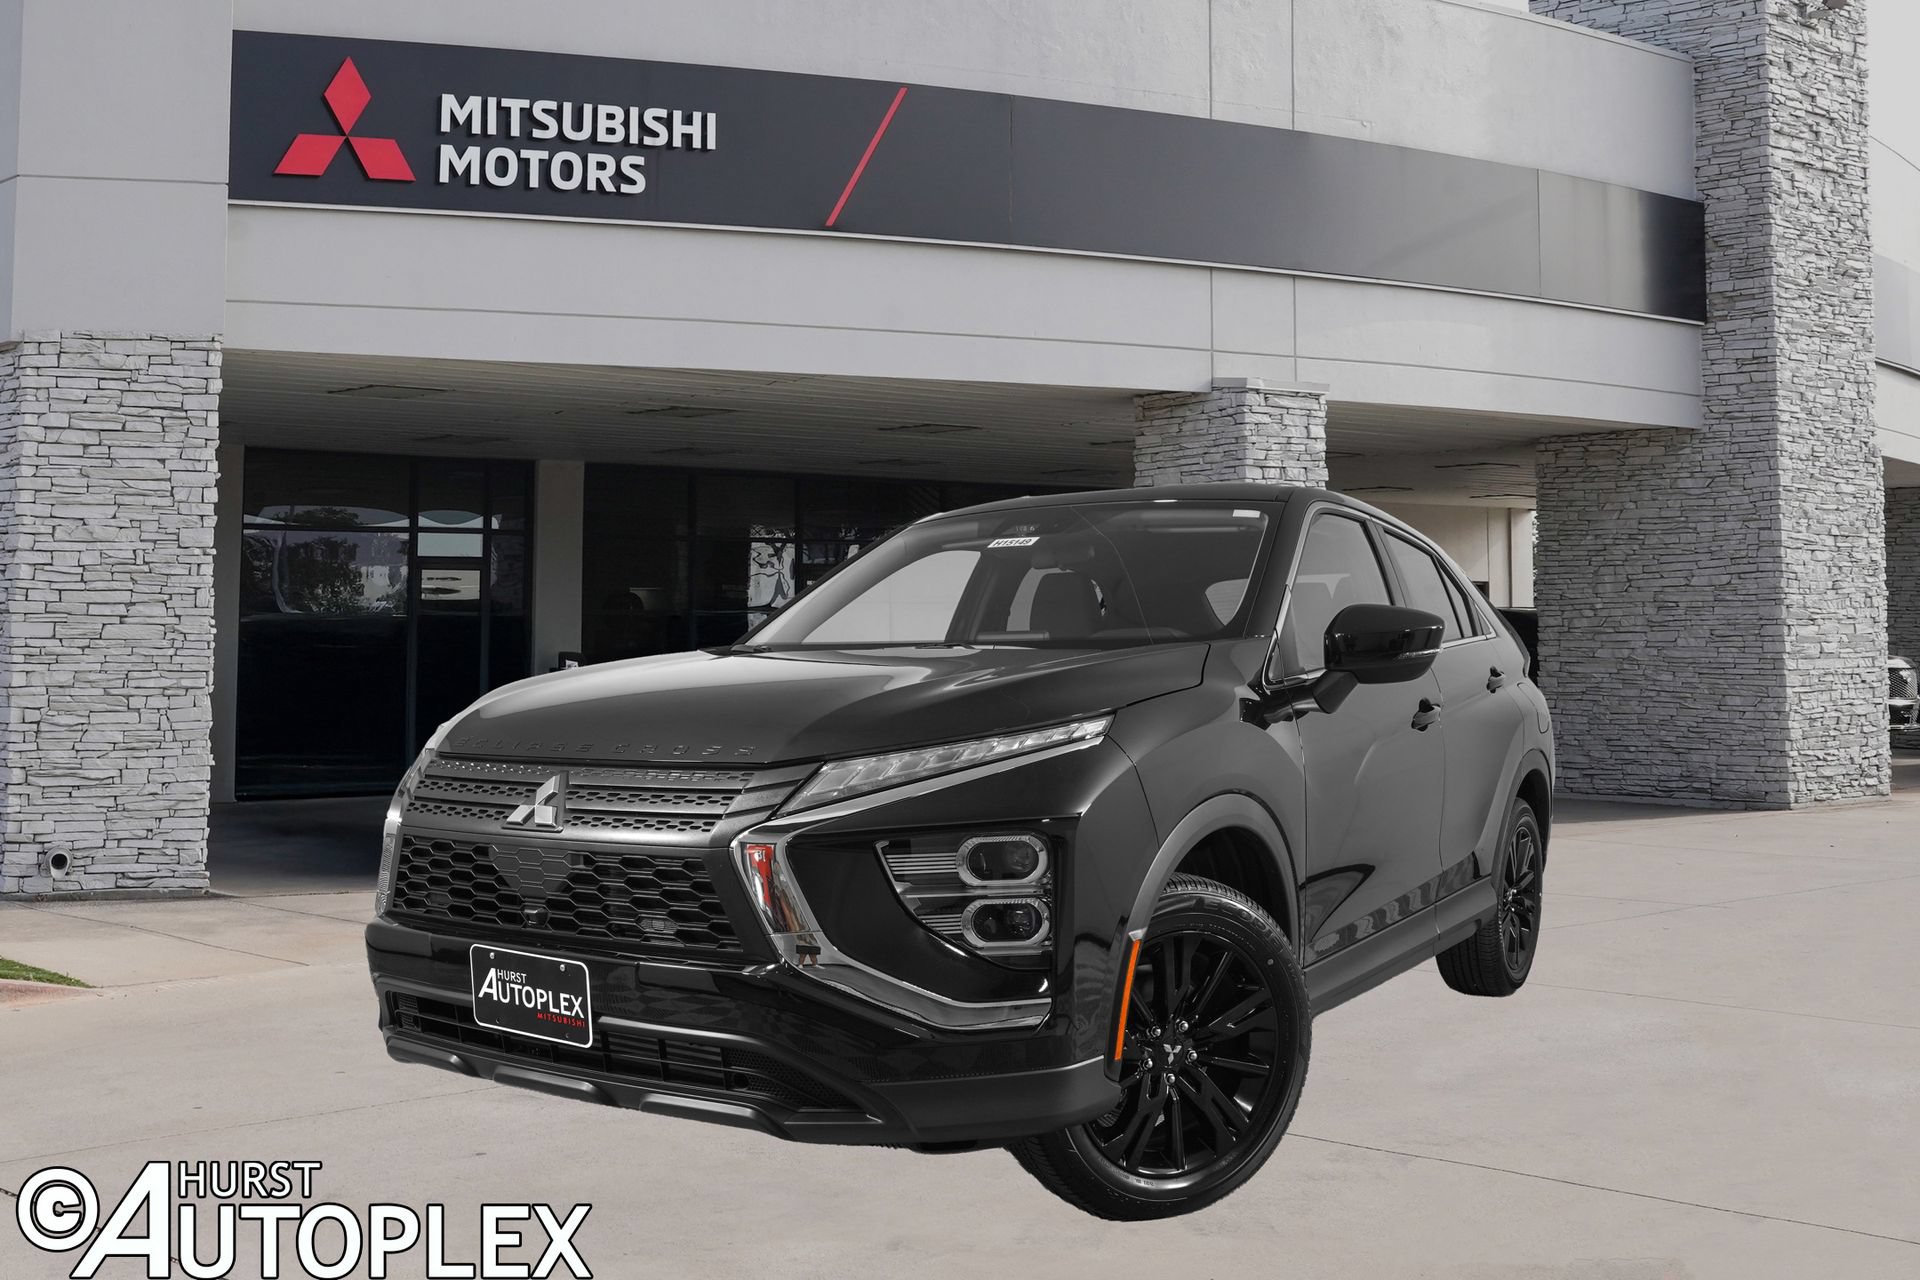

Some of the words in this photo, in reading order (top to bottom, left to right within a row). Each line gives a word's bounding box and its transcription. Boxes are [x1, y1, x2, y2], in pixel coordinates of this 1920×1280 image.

[438, 93, 718, 151] MITSUBISHI
[437, 144, 647, 195] MOTORS
[614, 743, 757, 756] CROSS
[497, 969, 527, 984] HURST
[478, 968, 585, 1019] AUTOPLEX
[537, 1012, 586, 1028] MITSUBISHI
